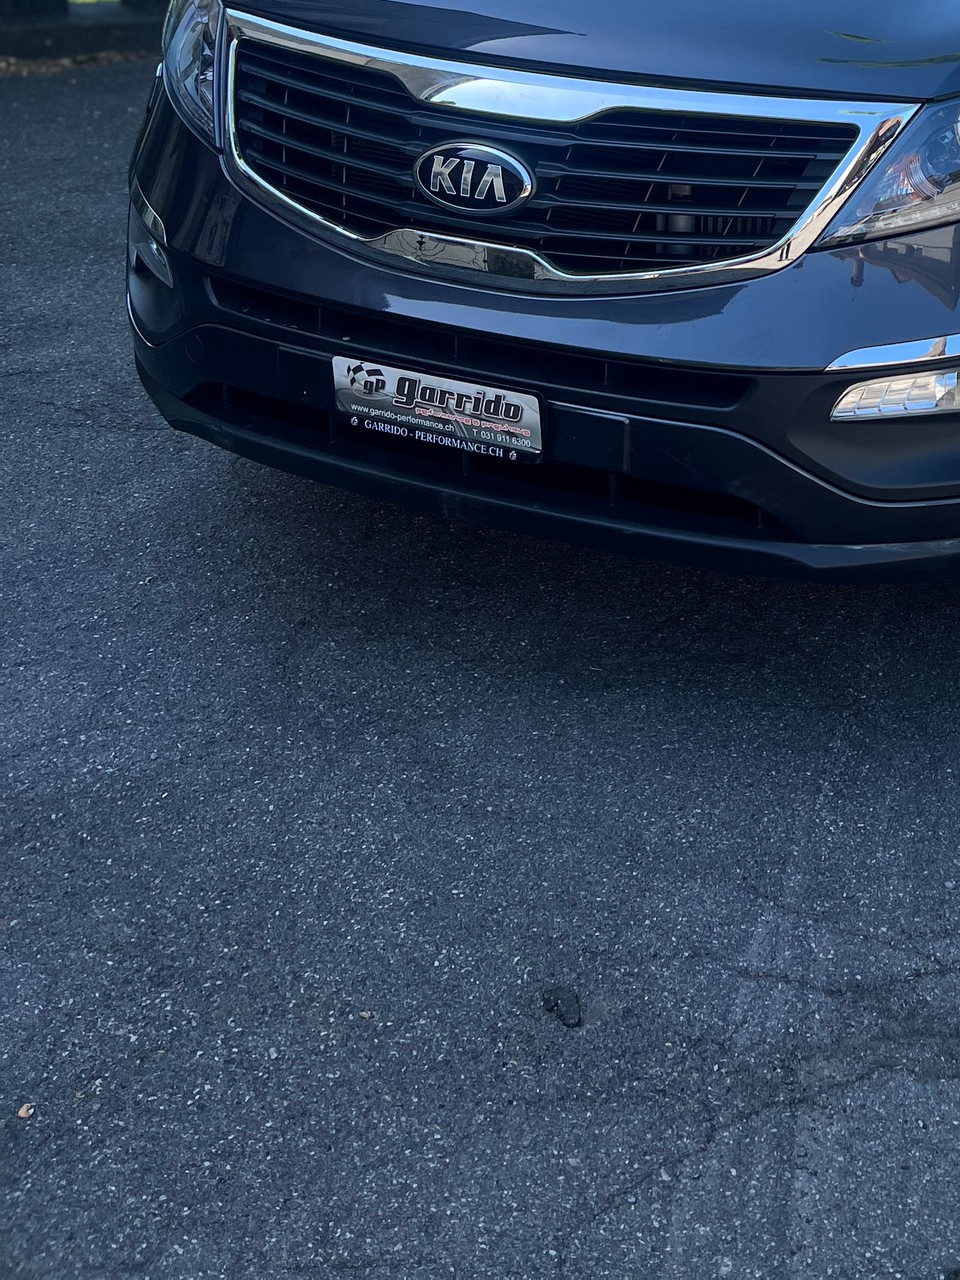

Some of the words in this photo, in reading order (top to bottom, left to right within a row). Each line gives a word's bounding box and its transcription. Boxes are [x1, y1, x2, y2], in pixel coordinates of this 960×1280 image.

[430, 155, 507, 202] KIA
[363, 378, 386, 395] gp
[392, 376, 523, 423] garrido
[364, 419, 408, 438] GARRIDO
[415, 430, 503, 458] PERFORMANCE.CH
[472, 428, 478, 437] T
[480, 430, 495, 440] 031
[496, 433, 509, 443] 911
[511, 436, 531, 448] 6300
